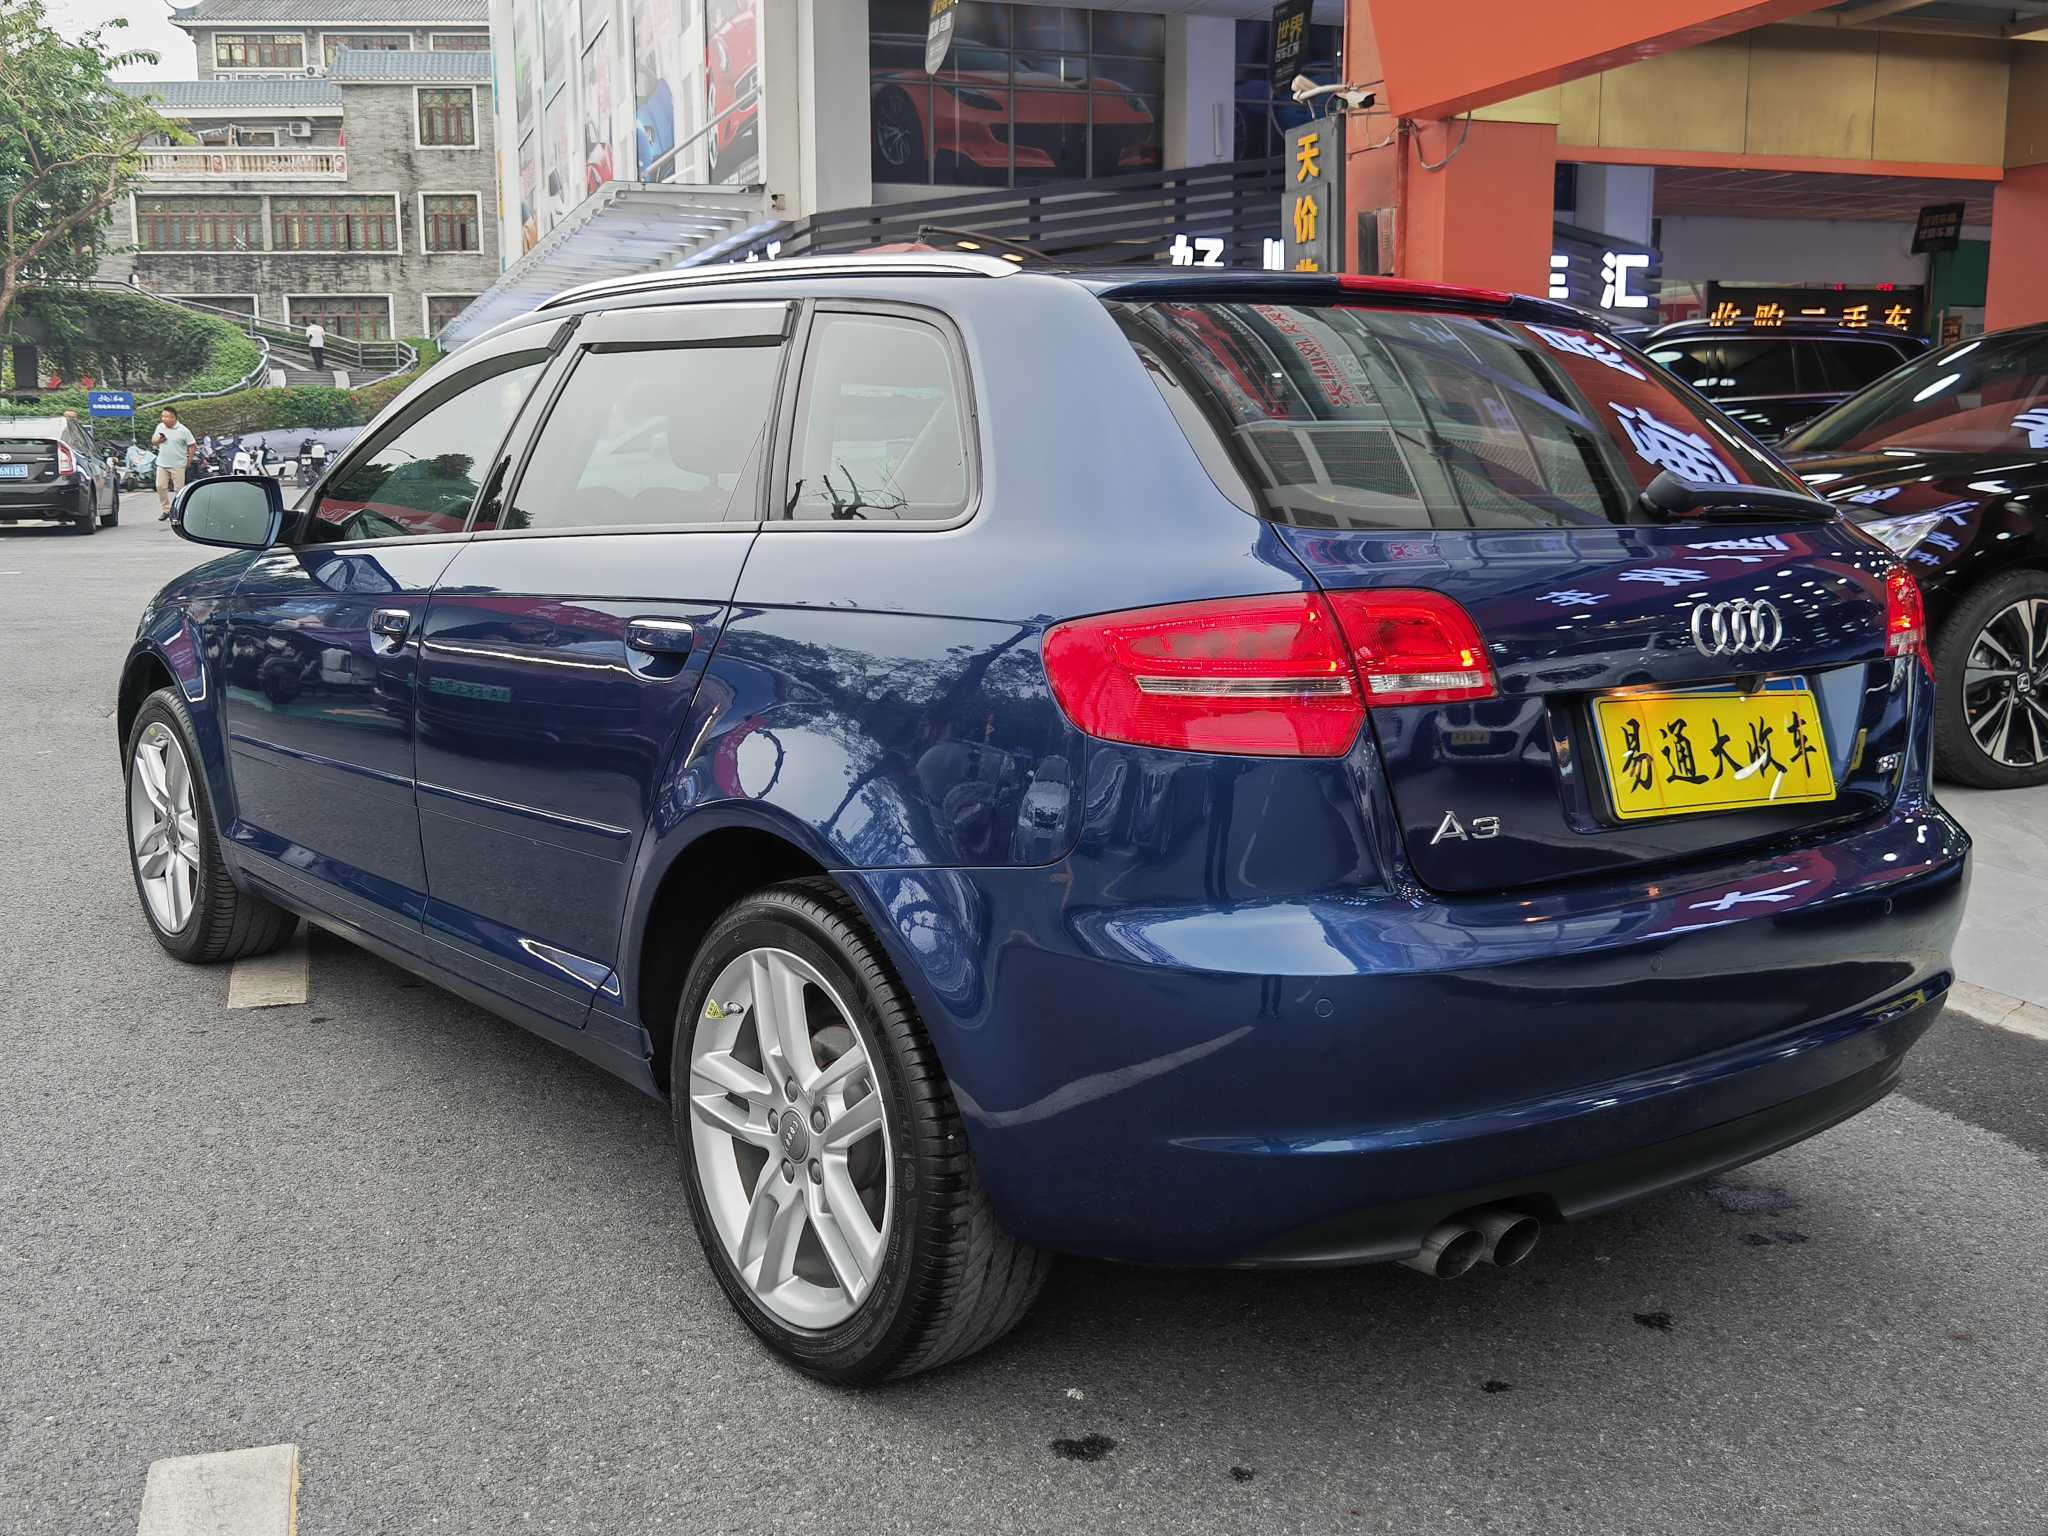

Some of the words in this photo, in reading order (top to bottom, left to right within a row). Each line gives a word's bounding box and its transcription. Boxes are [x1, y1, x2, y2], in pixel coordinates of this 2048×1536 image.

[1277, 12, 1304, 48] 世界
[1293, 133, 1321, 272] 天价
[1621, 710, 1817, 794] 易通大收车
[1429, 810, 1500, 845] A3
